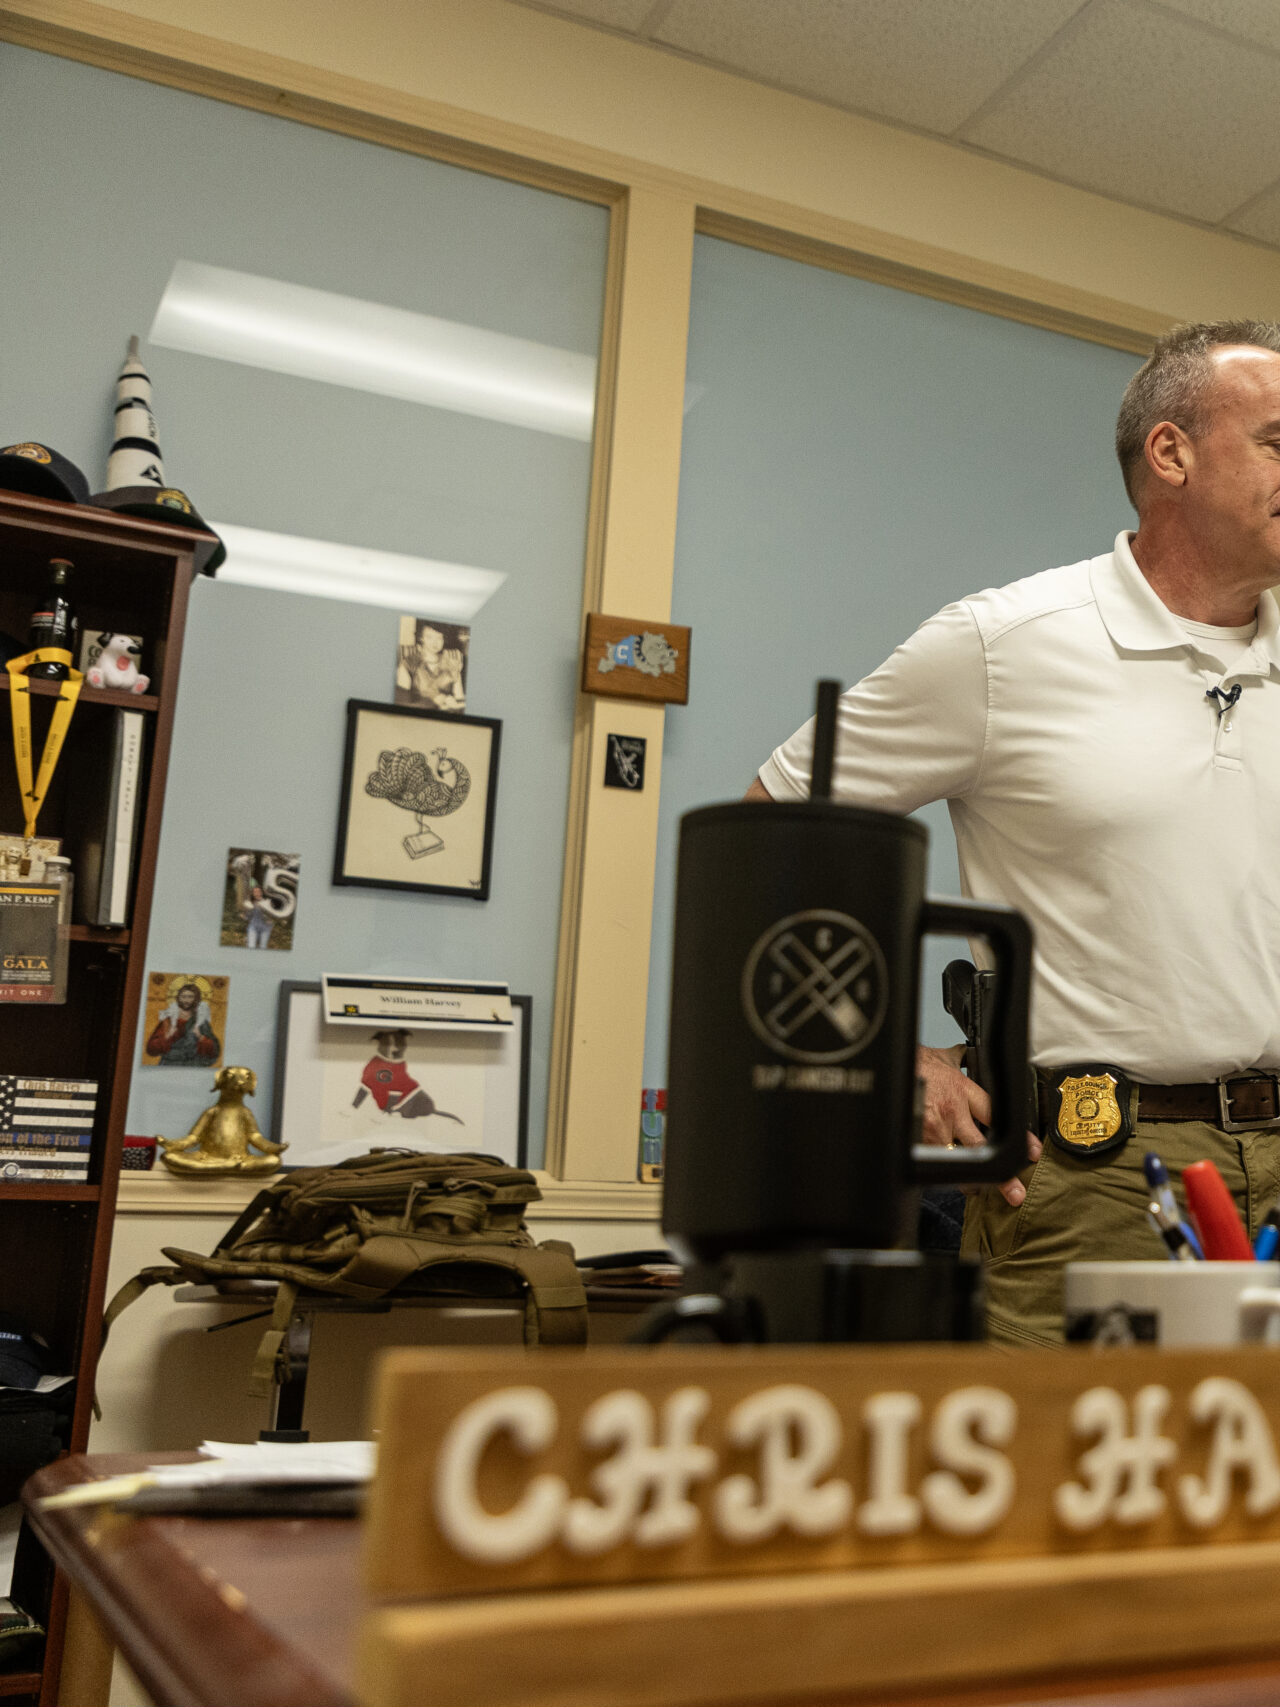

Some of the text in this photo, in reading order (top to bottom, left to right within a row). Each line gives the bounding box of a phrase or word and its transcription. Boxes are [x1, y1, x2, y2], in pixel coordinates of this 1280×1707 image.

[25, 895, 56, 904] KEMP
[4, 959, 48, 969] GALA
[379, 995, 463, 1009] William Harvey
[434, 1384, 1019, 1565] CHRIS
